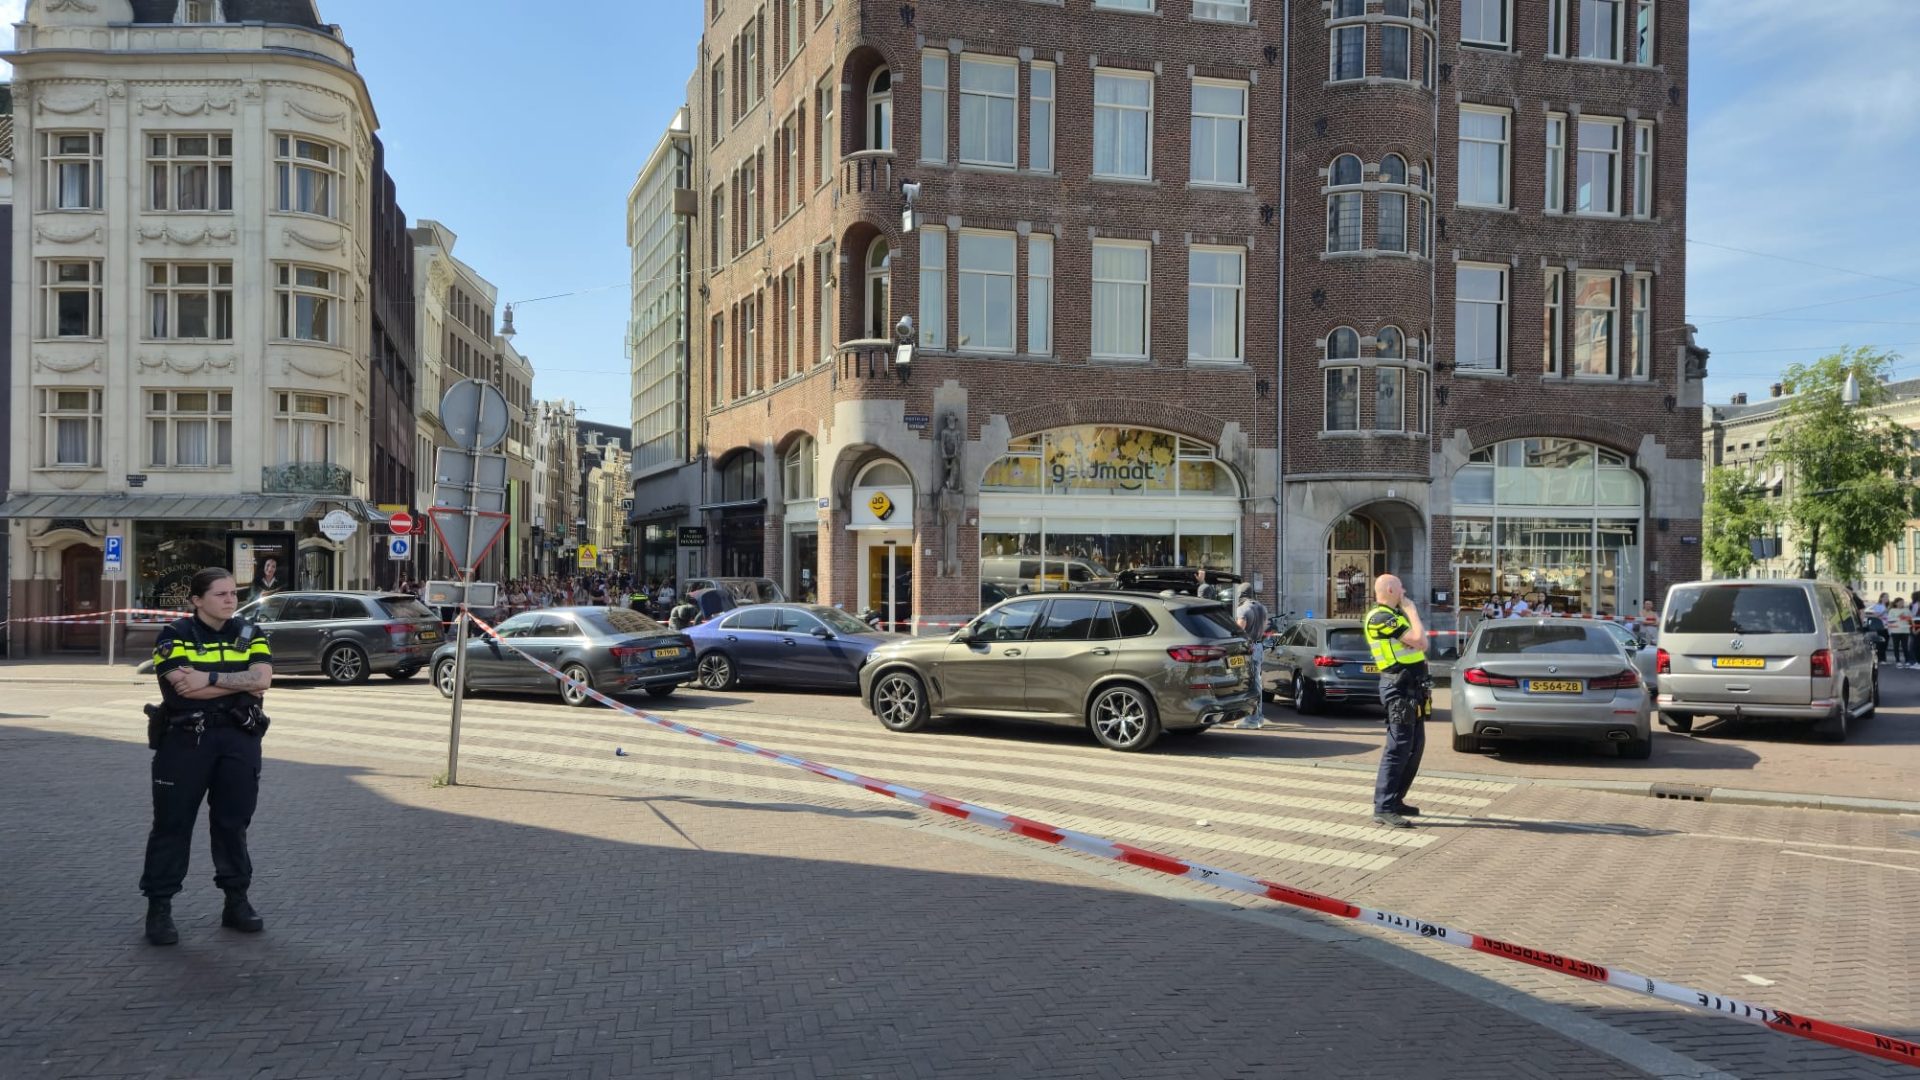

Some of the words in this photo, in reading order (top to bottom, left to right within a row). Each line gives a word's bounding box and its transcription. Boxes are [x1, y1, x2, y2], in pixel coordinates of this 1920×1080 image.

[109, 539, 118, 552] P
[1532, 681, 1578, 691] S-564-ZB
[1568, 958, 1605, 980] NIET
